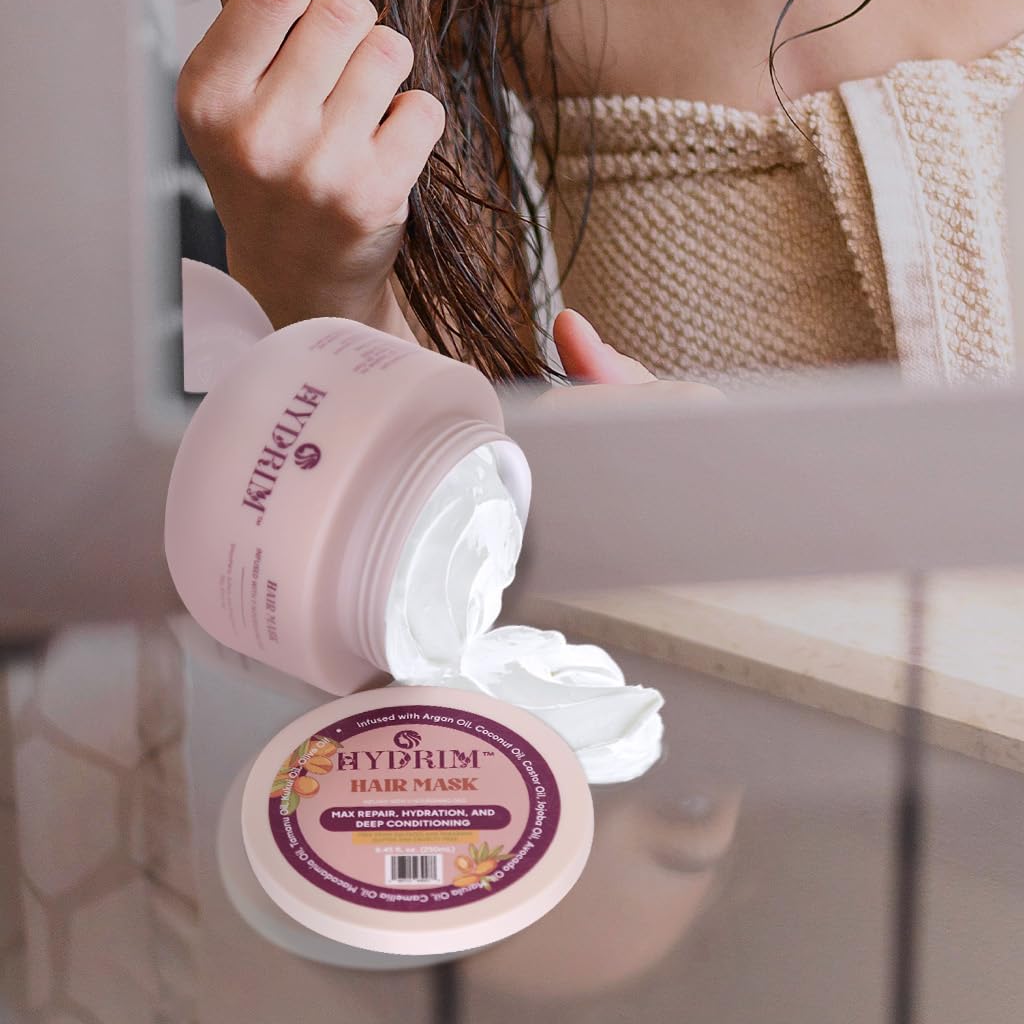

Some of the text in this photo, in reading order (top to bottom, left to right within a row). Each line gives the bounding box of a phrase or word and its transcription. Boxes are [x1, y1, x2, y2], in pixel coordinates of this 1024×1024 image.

[241, 382, 328, 513] HYDRIM
[356, 713, 396, 728] Infused
[397, 712, 420, 721] with
[422, 713, 454, 724] Argan
[475, 725, 513, 750] Coconut
[337, 749, 481, 772] HYDRIM
[522, 760, 541, 785] Castor
[281, 777, 295, 801] Kukui
[350, 777, 479, 793] HAIR MASK
[331, 810, 355, 818] MAX
[401, 809, 469, 818] HYDRATION,
[471, 808, 496, 817] AND
[355, 819, 471, 828] DEEP CONDITIONING
[534, 802, 547, 826] Jojoba
[282, 816, 300, 848] Tamanu
[502, 841, 535, 872] Avocado
[307, 859, 359, 894] Macadamia
[379, 893, 429, 903] Camellia
